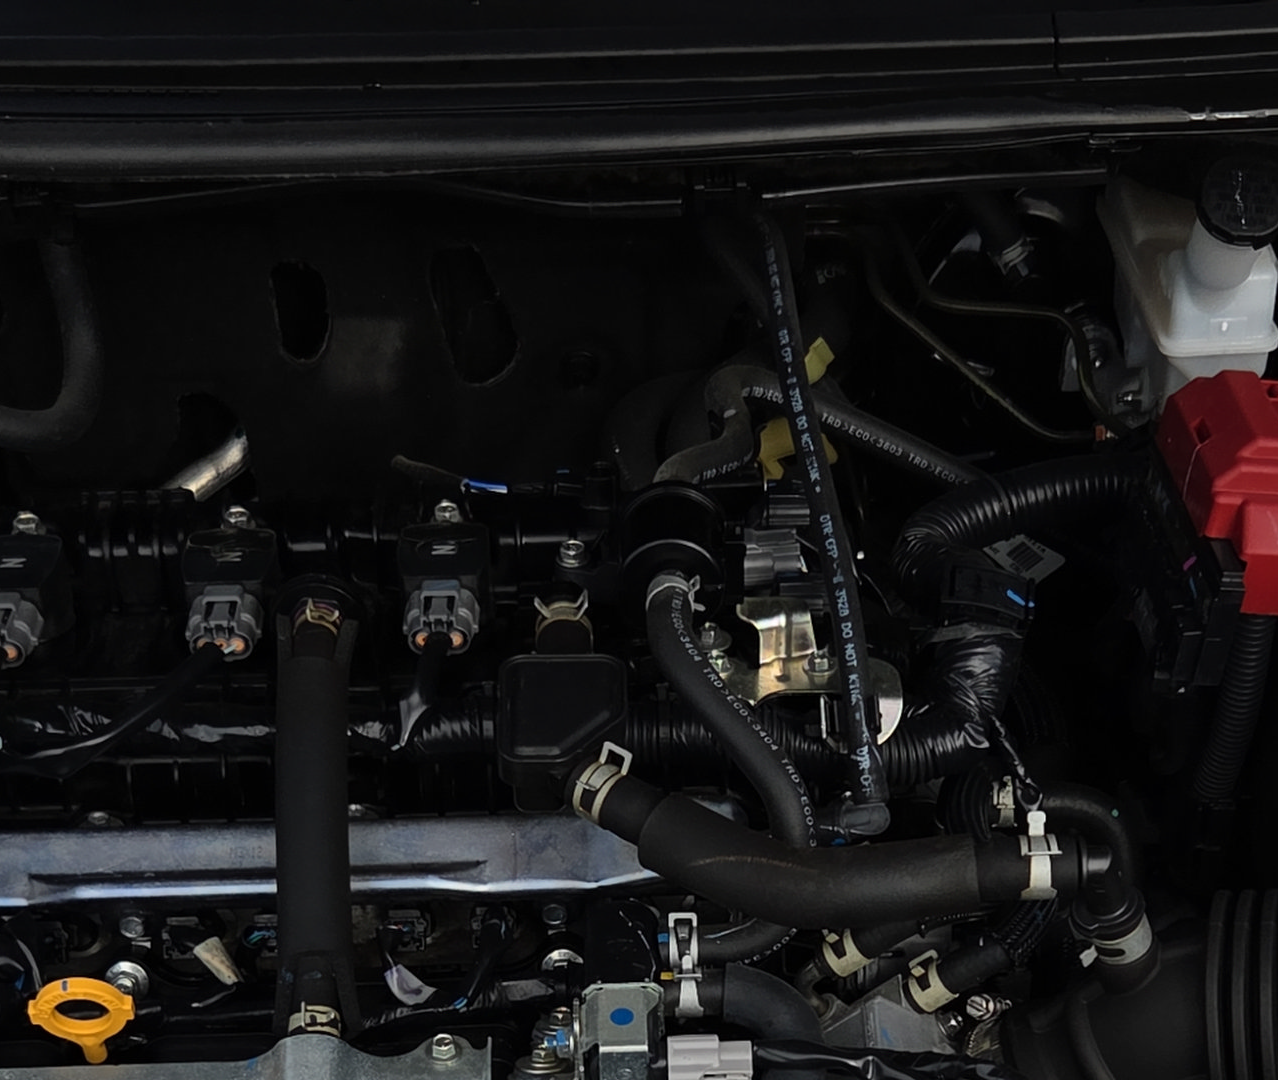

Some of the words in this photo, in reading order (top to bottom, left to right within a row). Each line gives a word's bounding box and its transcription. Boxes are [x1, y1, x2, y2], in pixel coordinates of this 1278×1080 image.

[840, 621, 854, 639] DO
[844, 643, 858, 668] NOT
[703, 666, 779, 752] TRD>ECO<3404
